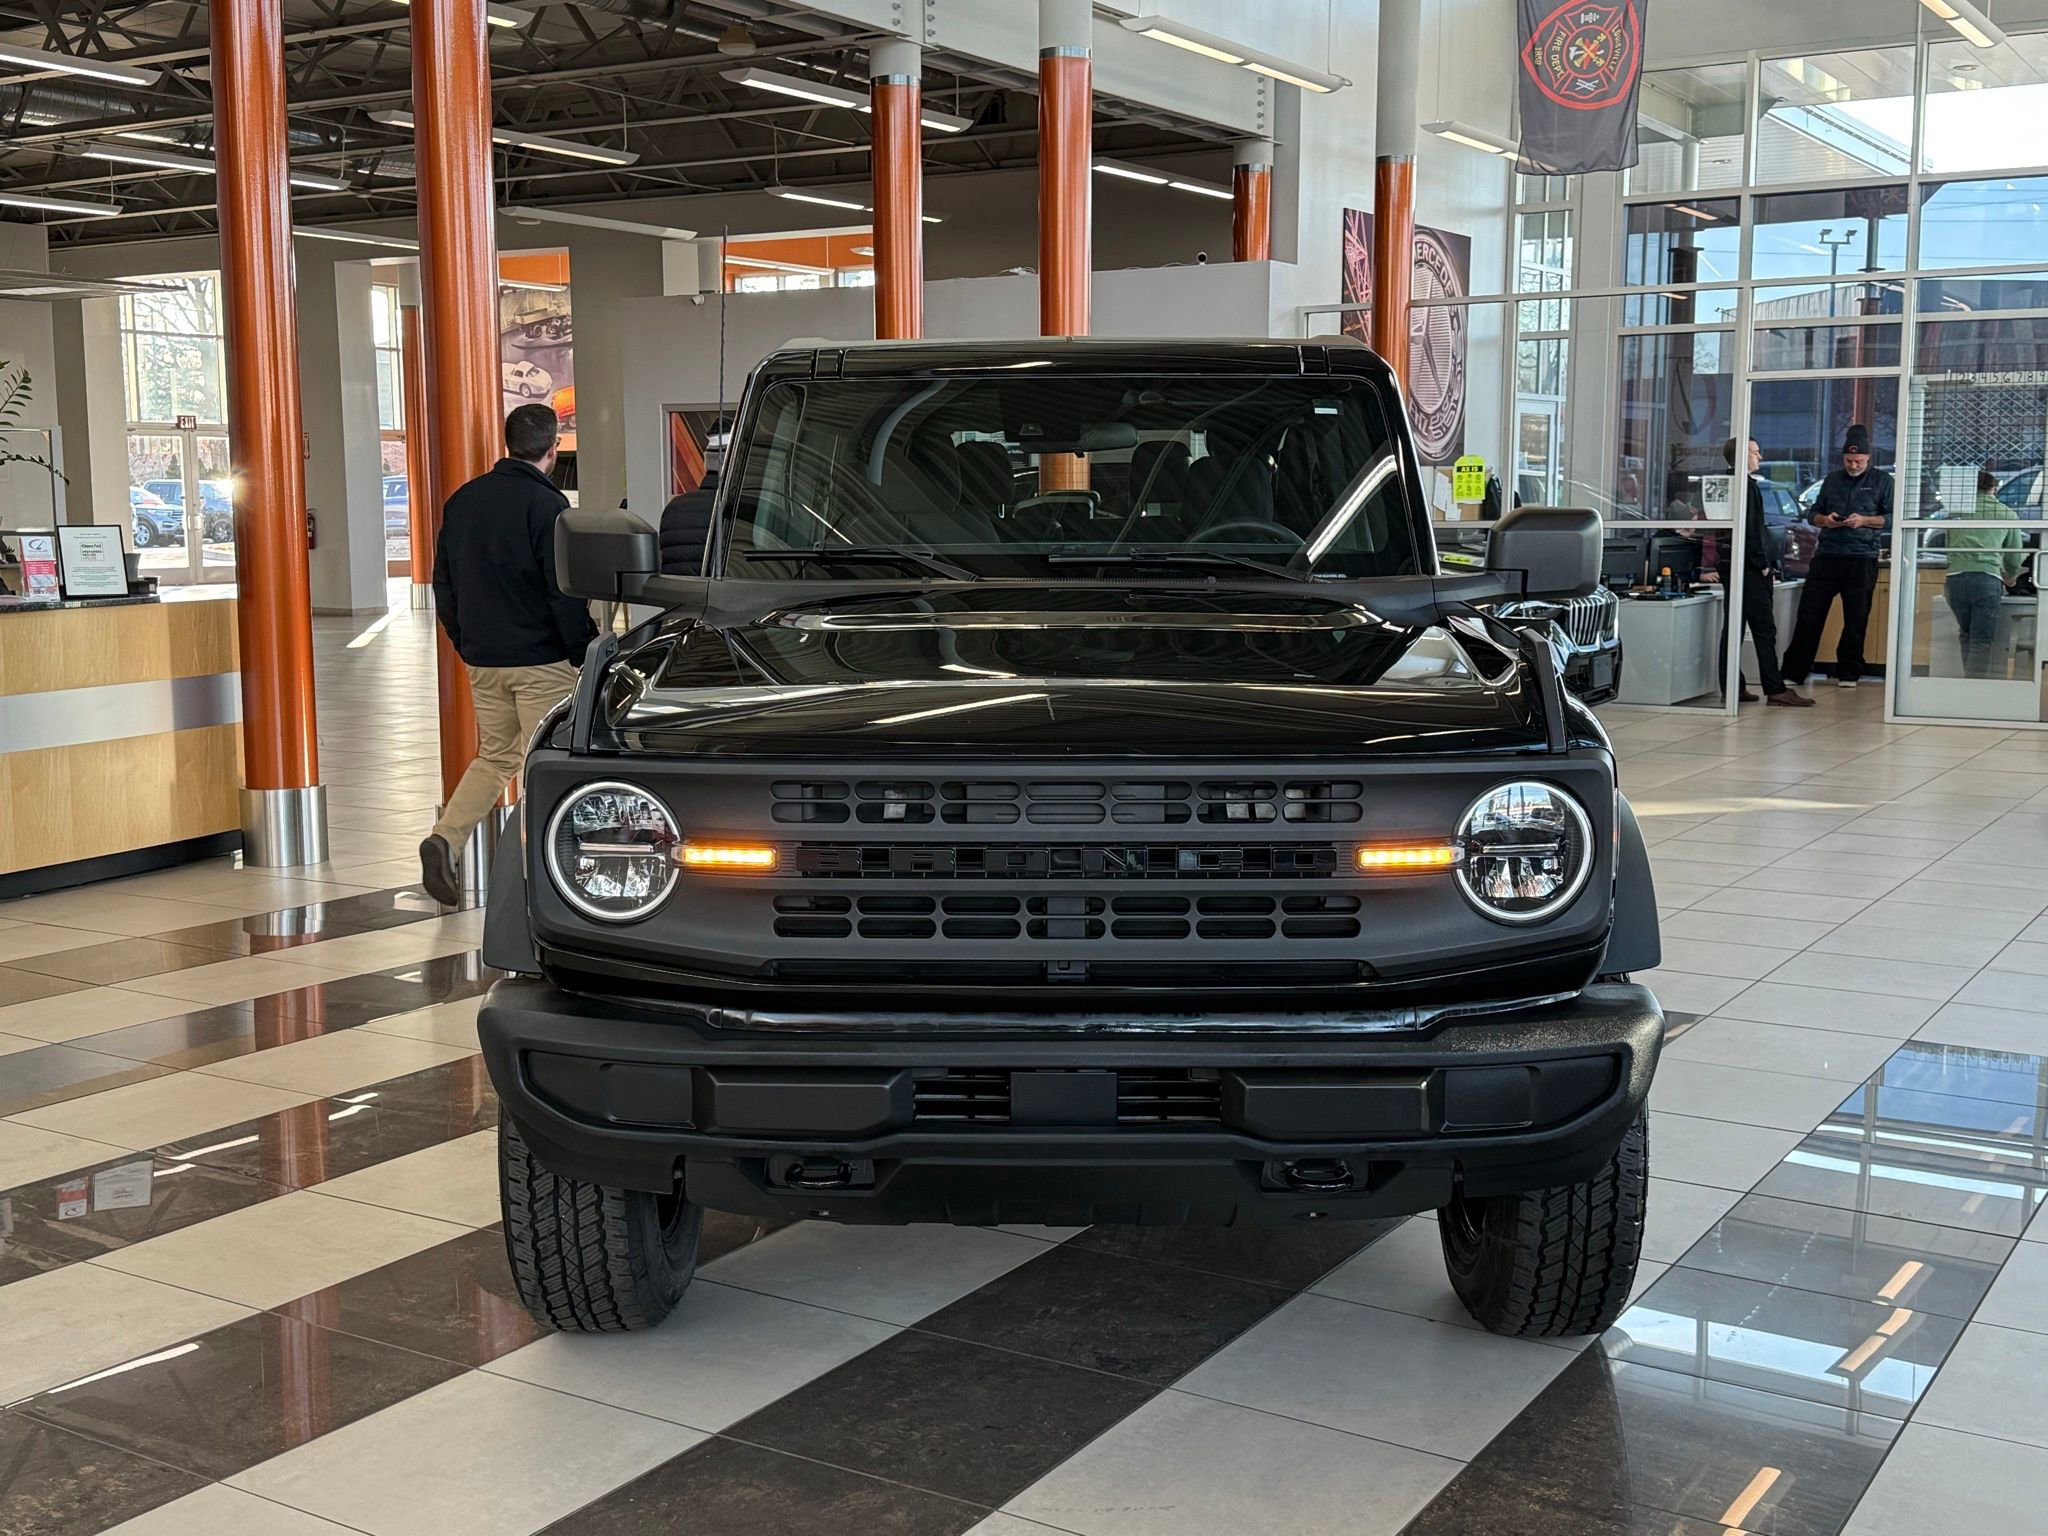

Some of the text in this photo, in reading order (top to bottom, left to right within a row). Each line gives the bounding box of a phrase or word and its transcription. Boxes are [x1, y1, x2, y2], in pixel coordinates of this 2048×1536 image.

[1552, 31, 1567, 52] FIRE
[1608, 24, 1622, 72] LOUISVILLE
[180, 416, 195, 429] EXIT
[796, 847, 1338, 874] BRONCO
